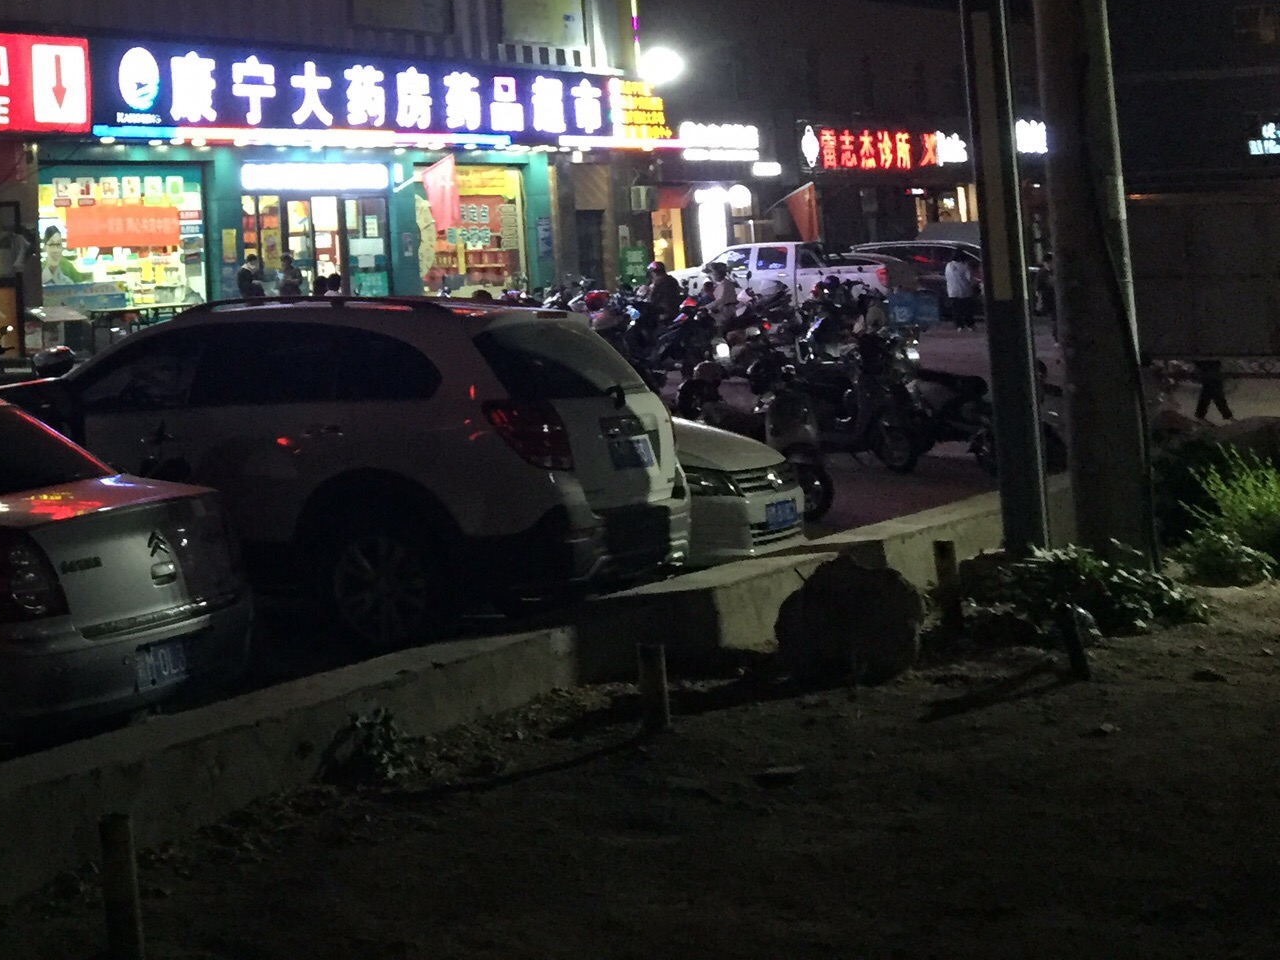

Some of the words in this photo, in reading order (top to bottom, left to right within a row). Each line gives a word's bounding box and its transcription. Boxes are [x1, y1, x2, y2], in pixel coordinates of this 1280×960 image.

[170, 50, 603, 134] 康宁大药房药品超市
[819, 129, 911, 169] 雷志杰诊所
